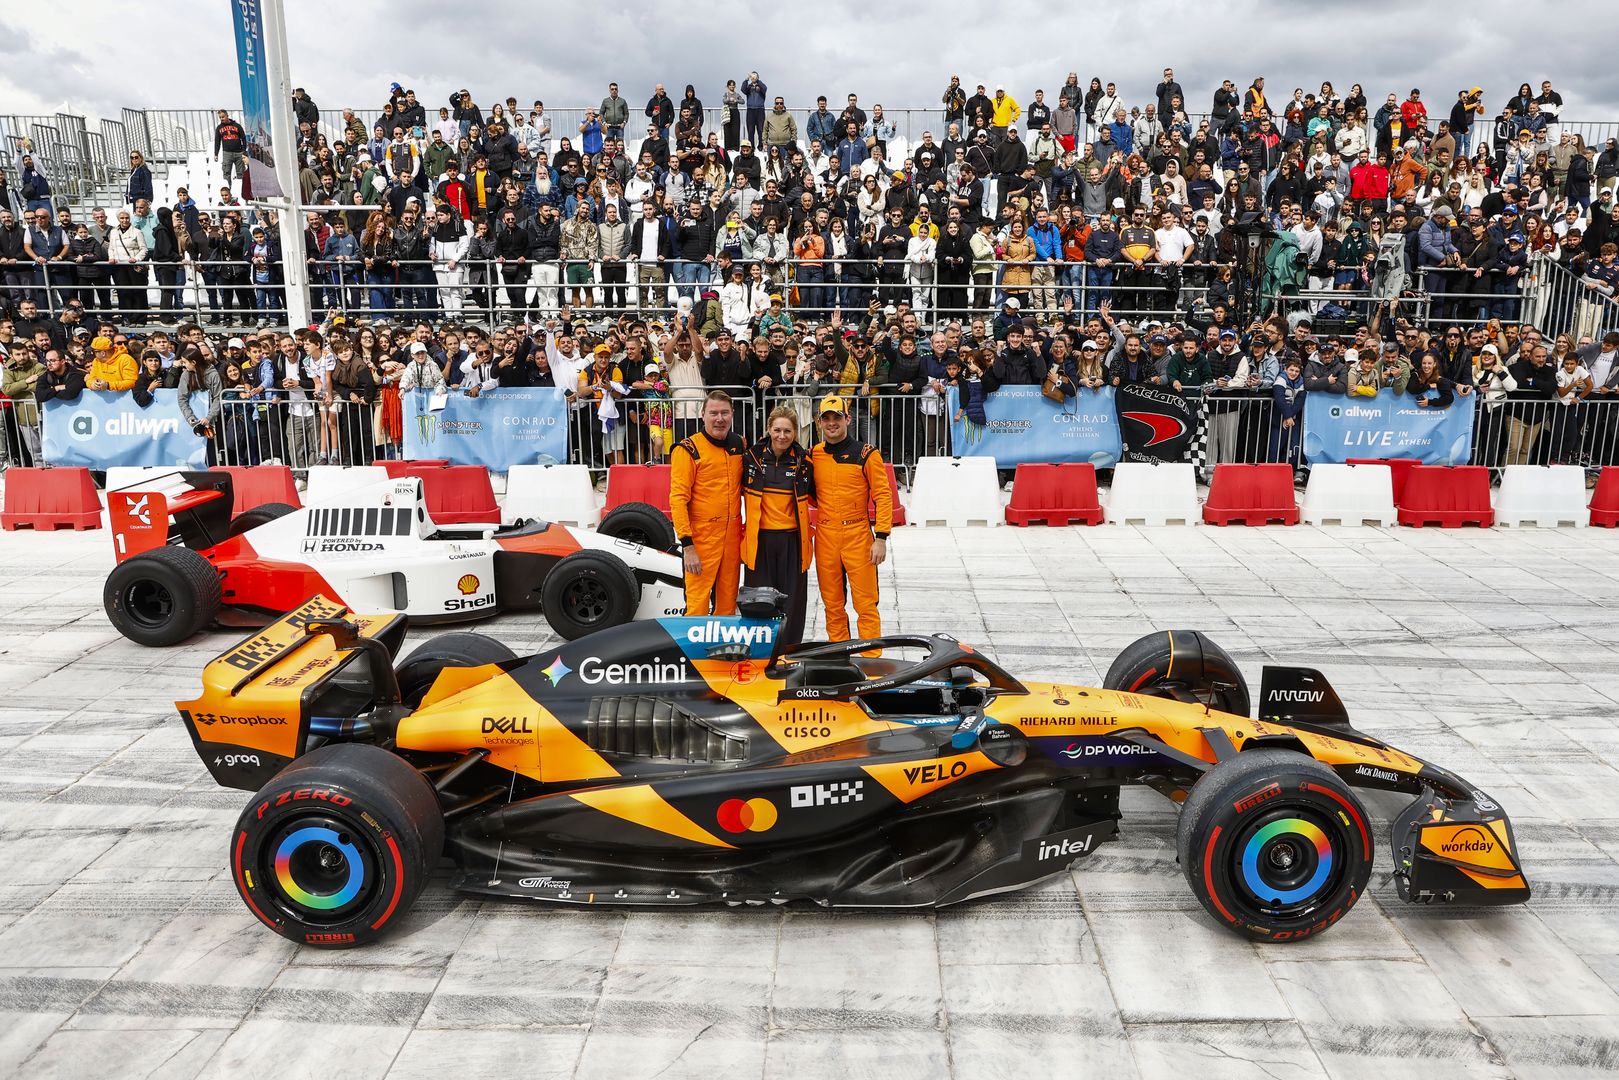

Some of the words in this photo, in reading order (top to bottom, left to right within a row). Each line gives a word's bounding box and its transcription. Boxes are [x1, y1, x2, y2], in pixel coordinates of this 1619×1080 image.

[245, 37, 255, 78] The
[499, 392, 532, 401] sponsors
[1011, 391, 1025, 400] you
[1123, 384, 1190, 415] McLaren
[1053, 414, 1108, 424] CONRAD
[1345, 406, 1382, 420] allwyn
[105, 412, 179, 440] allwyn
[437, 420, 484, 430] MONSTER
[503, 416, 556, 426] CONRAD
[985, 420, 1032, 428] MONSTER
[1343, 430, 1394, 446] LIVE
[1398, 438, 1432, 446] ATHENS
[115, 533, 127, 554] 1
[320, 543, 385, 552] HONDA
[444, 593, 495, 611] Shell
[687, 621, 772, 646] allwyn
[579, 656, 687, 685] Gemini
[738, 664, 751, 682] E
[872, 680, 895, 689] MOUNTAIN
[796, 688, 820, 698] okta
[1268, 689, 1325, 702] ARROW
[219, 715, 288, 727] Dropbox
[482, 716, 532, 734] DELL
[1020, 717, 1076, 726] RICHARD
[1080, 716, 1118, 726] MILLE
[784, 727, 831, 738] CISCO
[483, 736, 535, 745] Technologies
[1085, 745, 1105, 756] DP
[224, 754, 261, 767] groq
[903, 761, 967, 786] VELO
[1355, 765, 1373, 776] JACK
[257, 801, 270, 820] P
[275, 788, 353, 807] ZERO
[1233, 782, 1282, 813] PIRELLI
[1038, 835, 1093, 861] intel
[1441, 840, 1494, 853] workday
